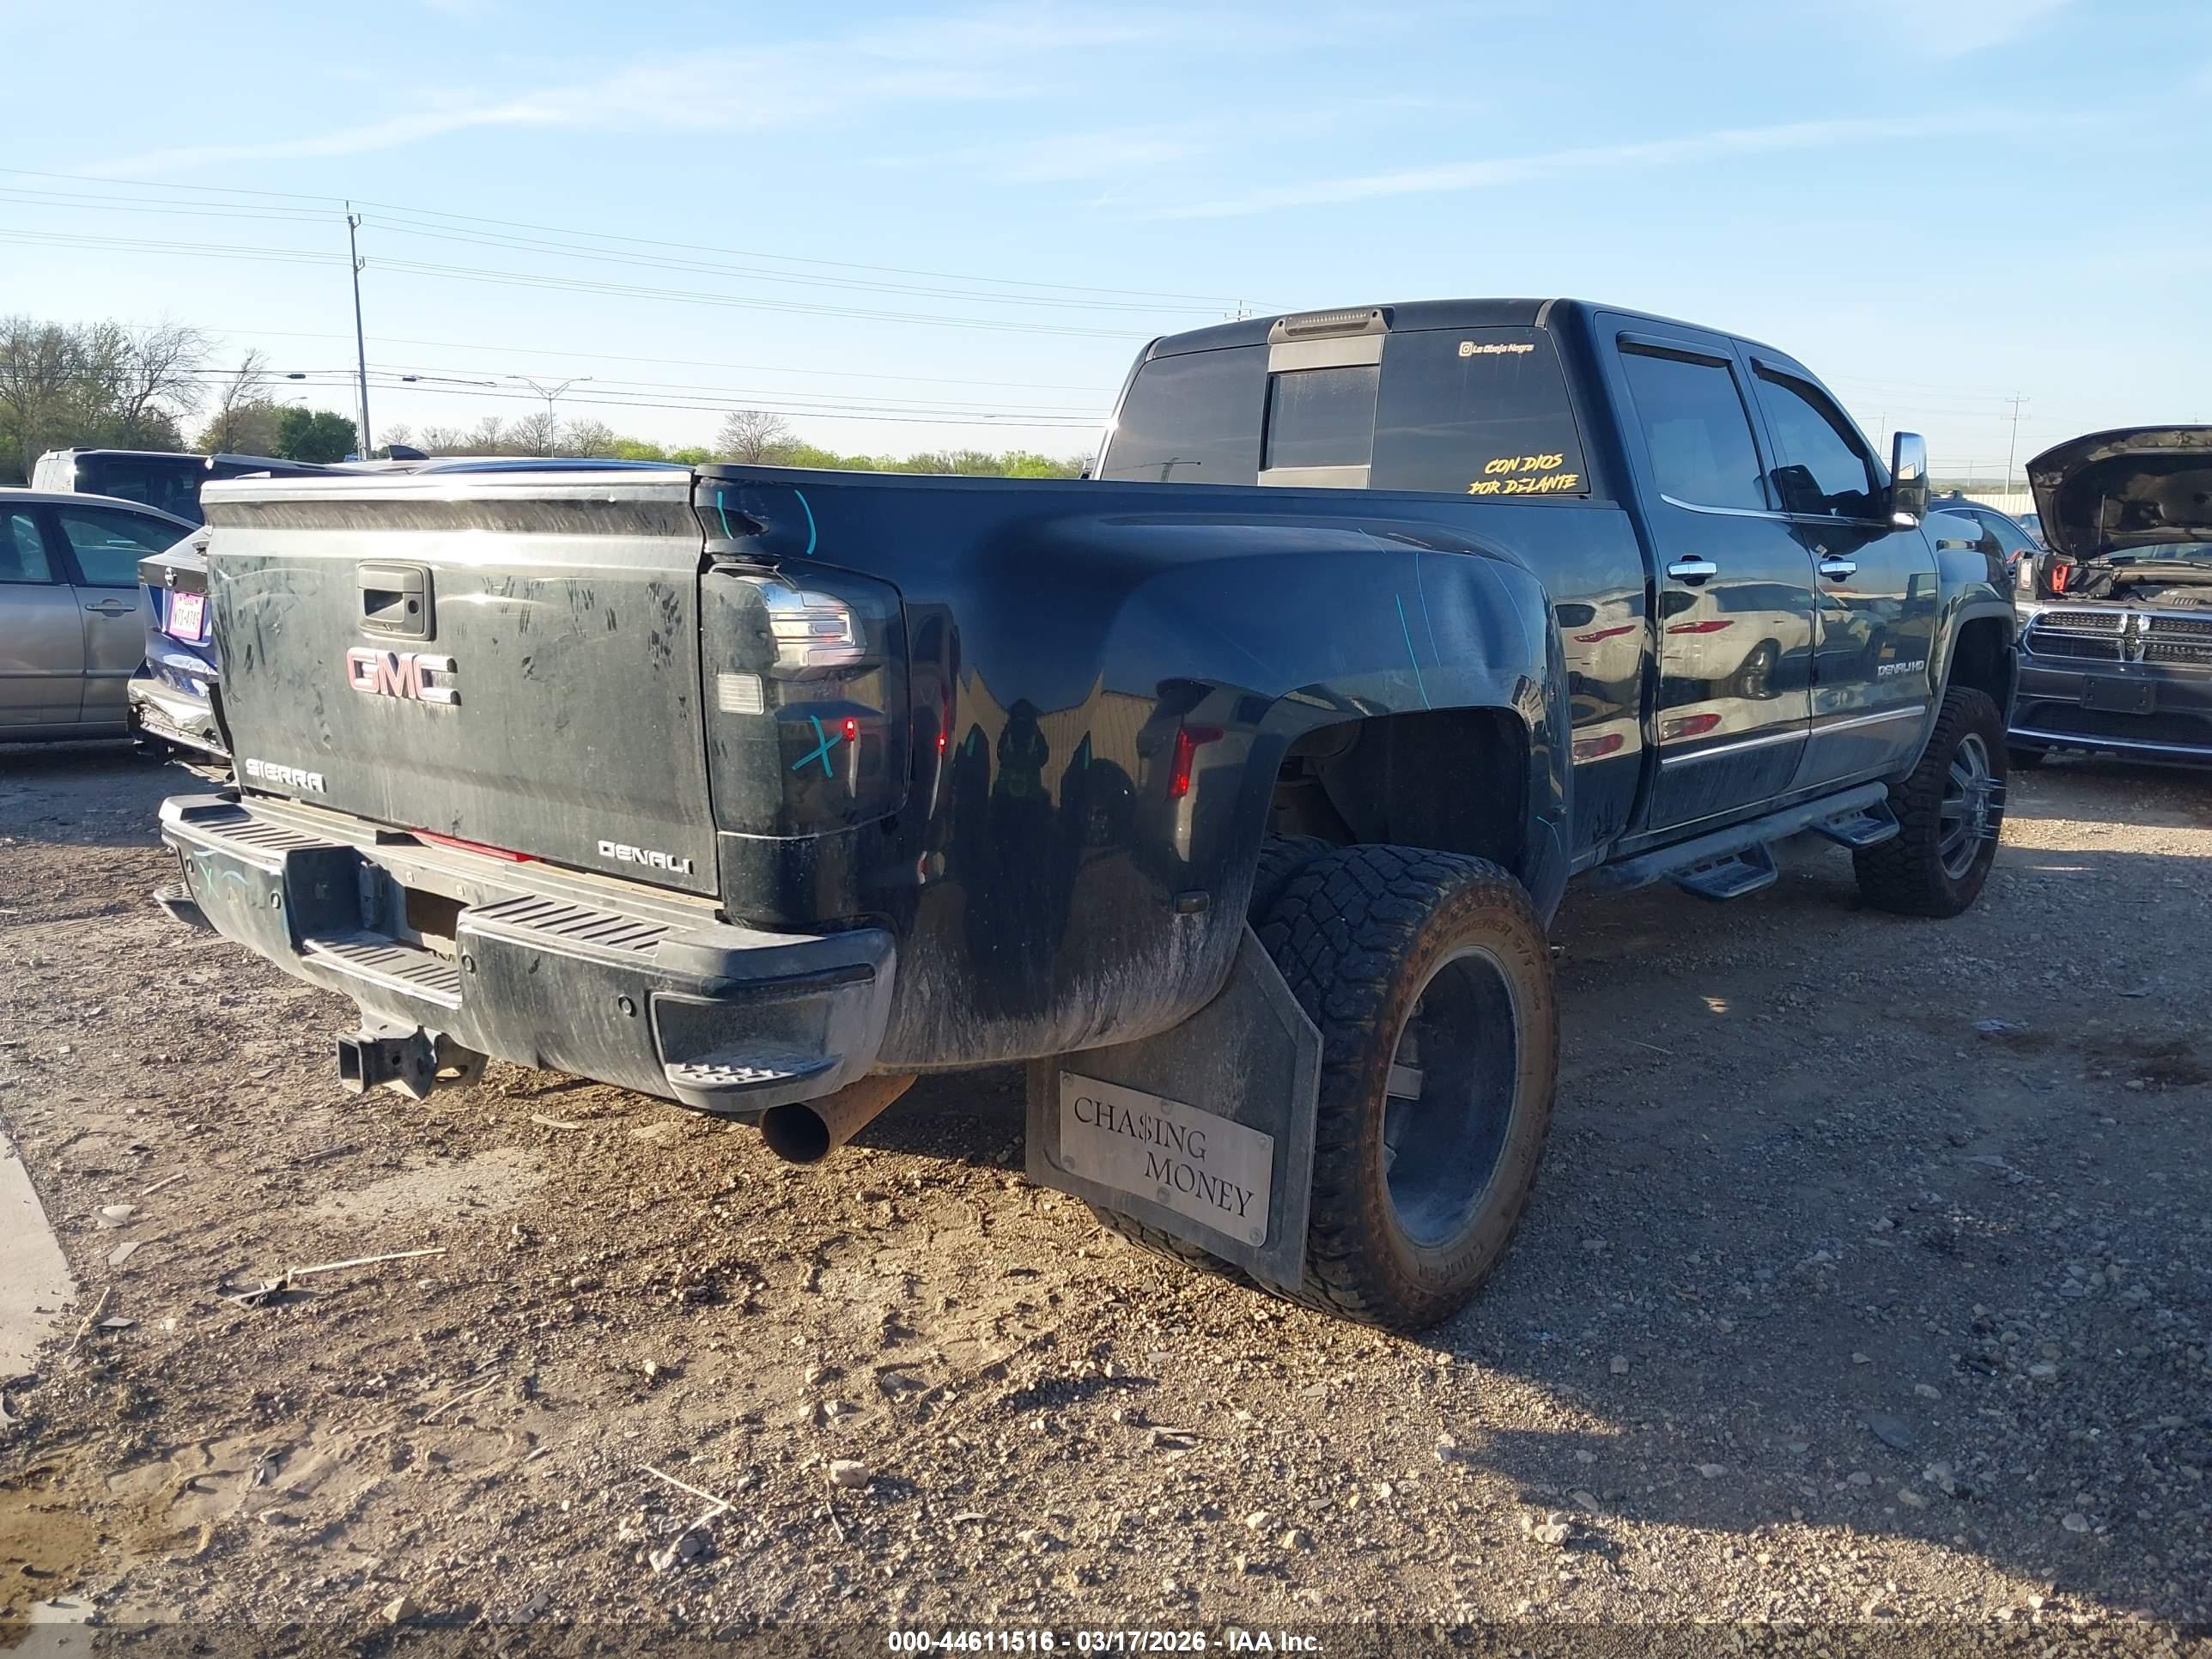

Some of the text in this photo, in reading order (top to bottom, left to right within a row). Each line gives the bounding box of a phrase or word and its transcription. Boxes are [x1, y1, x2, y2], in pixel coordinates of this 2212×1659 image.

[1485, 453, 1564, 475] CON DIOS
[1467, 474, 1579, 495] POR DELANTE
[347, 647, 462, 706] GMC
[1878, 659, 1924, 676] DENALI HD
[246, 758, 326, 793] SIERRA
[598, 840, 694, 875] DENALI
[1145, 1151, 1254, 1218] MONEY
